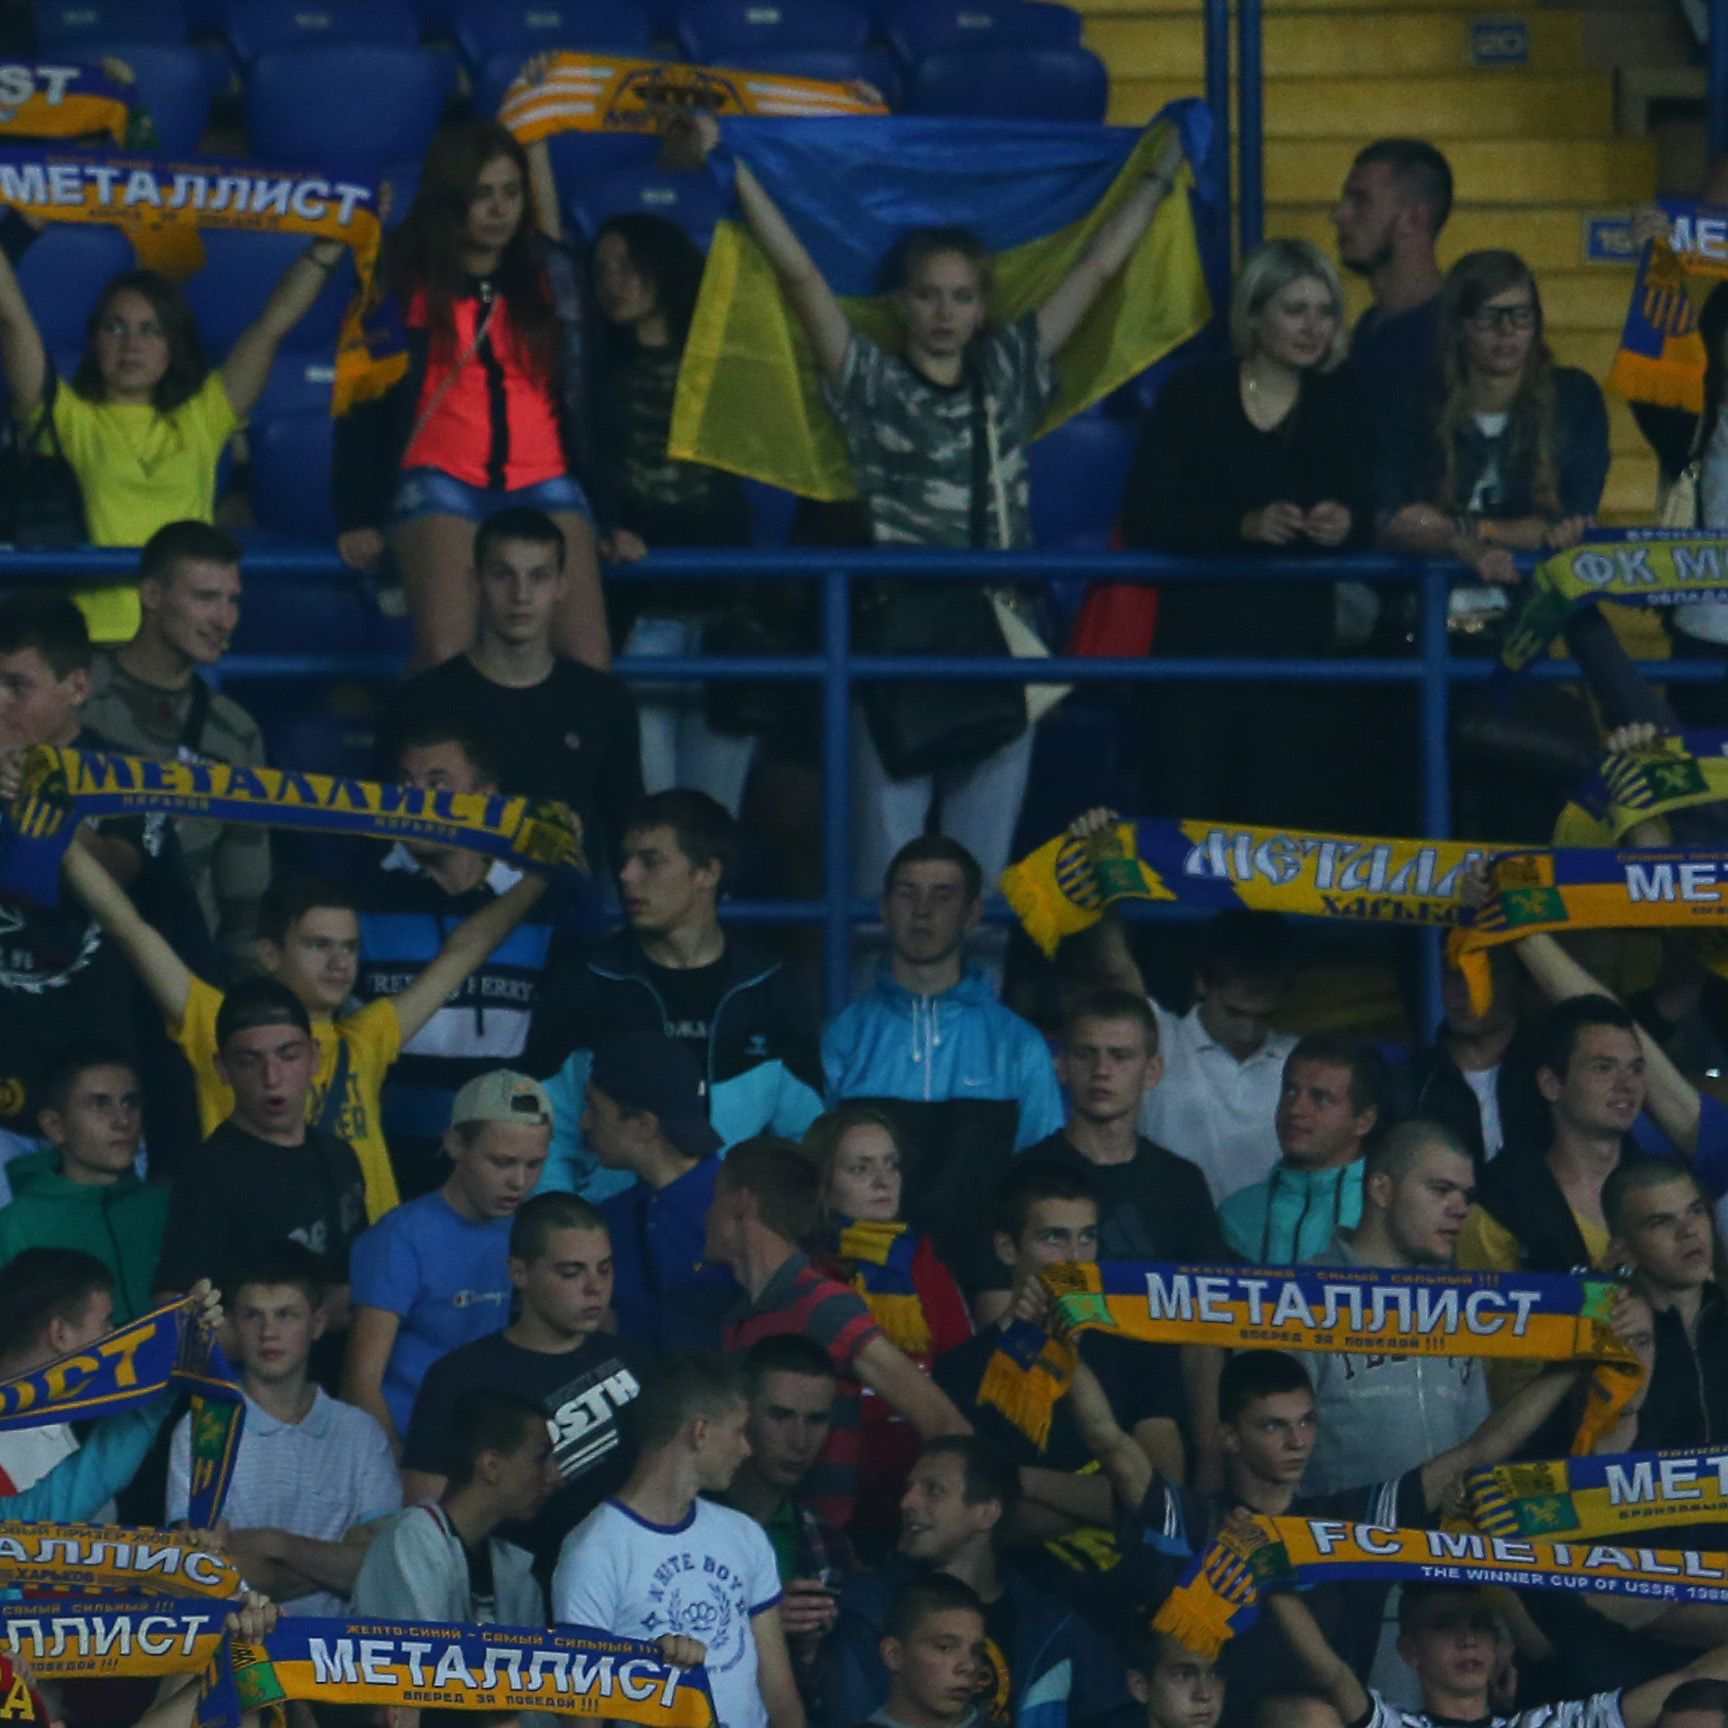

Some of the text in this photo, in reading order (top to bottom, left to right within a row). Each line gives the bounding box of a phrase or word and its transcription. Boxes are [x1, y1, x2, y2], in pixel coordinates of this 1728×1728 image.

[1145, 1270, 1543, 1336] МЕТАЛЛИСТ
[1306, 1521, 1404, 1556] FC
[647, 1554, 742, 1603] WHITE BOY
[1420, 1565, 1676, 1598] THE WINNER CUP OF USSR
[346, 1624, 462, 1641] ЖЕЛТО-СИНИЙ
[307, 1637, 683, 1708] МЕТАЛЛИСТ
